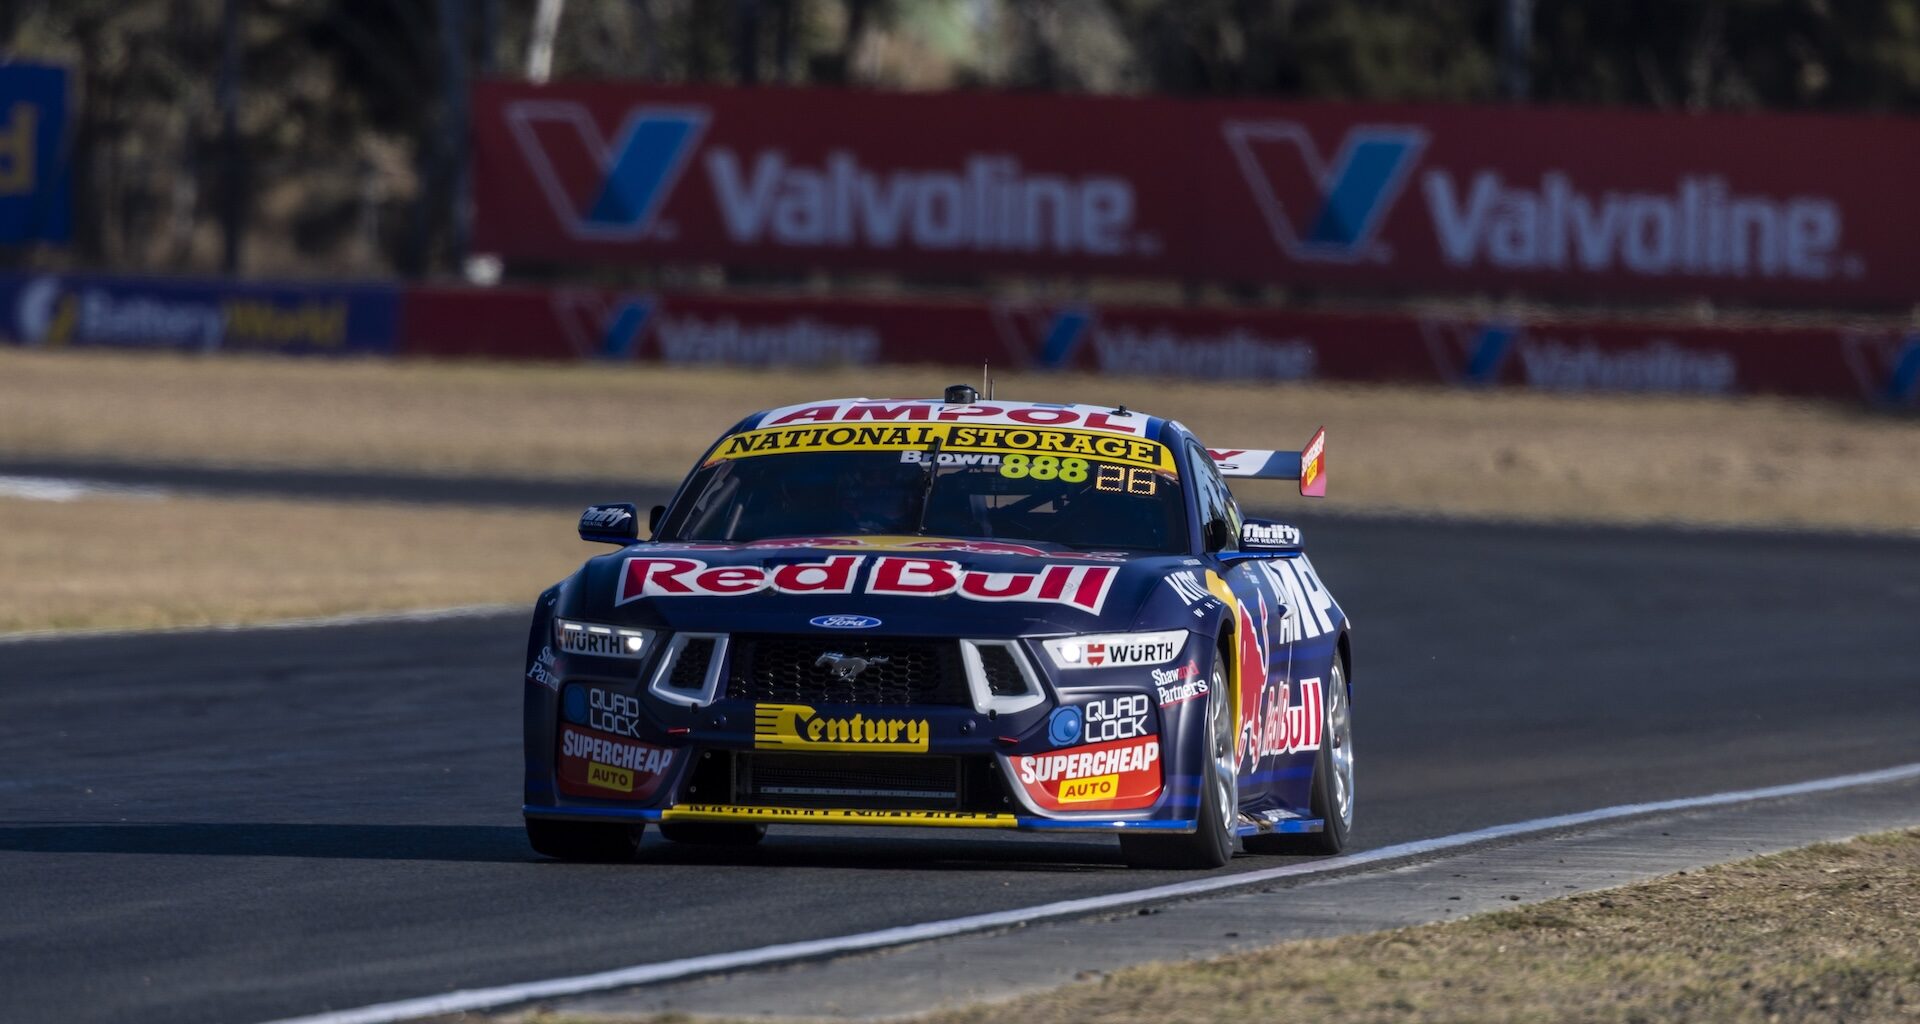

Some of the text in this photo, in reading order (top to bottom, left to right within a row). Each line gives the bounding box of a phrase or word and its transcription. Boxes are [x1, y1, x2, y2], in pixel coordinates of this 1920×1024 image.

[706, 148, 1135, 254] Valvoline
[1422, 170, 1842, 278] Valvoline
[768, 405, 1136, 433] AMPOL
[726, 427, 1154, 464] NATIONAL STORAGE
[901, 450, 1090, 483] Brown 888
[1096, 464, 1156, 496] 26
[1242, 523, 1300, 545] Thrifty
[615, 555, 1120, 616] Red Bull
[1109, 642, 1173, 663] WÜRTH
[590, 688, 639, 718] QUAD
[1085, 694, 1149, 721] QUAD
[1158, 679, 1208, 706] Partners
[590, 707, 641, 738] LOCK
[755, 703, 930, 753] Century
[1085, 715, 1148, 743] LOCK
[563, 728, 674, 776] SUPERCHEAP
[1020, 741, 1160, 785] SUPERCHEAP
[592, 768, 629, 786] AUTO
[1065, 781, 1112, 798] AUTO
